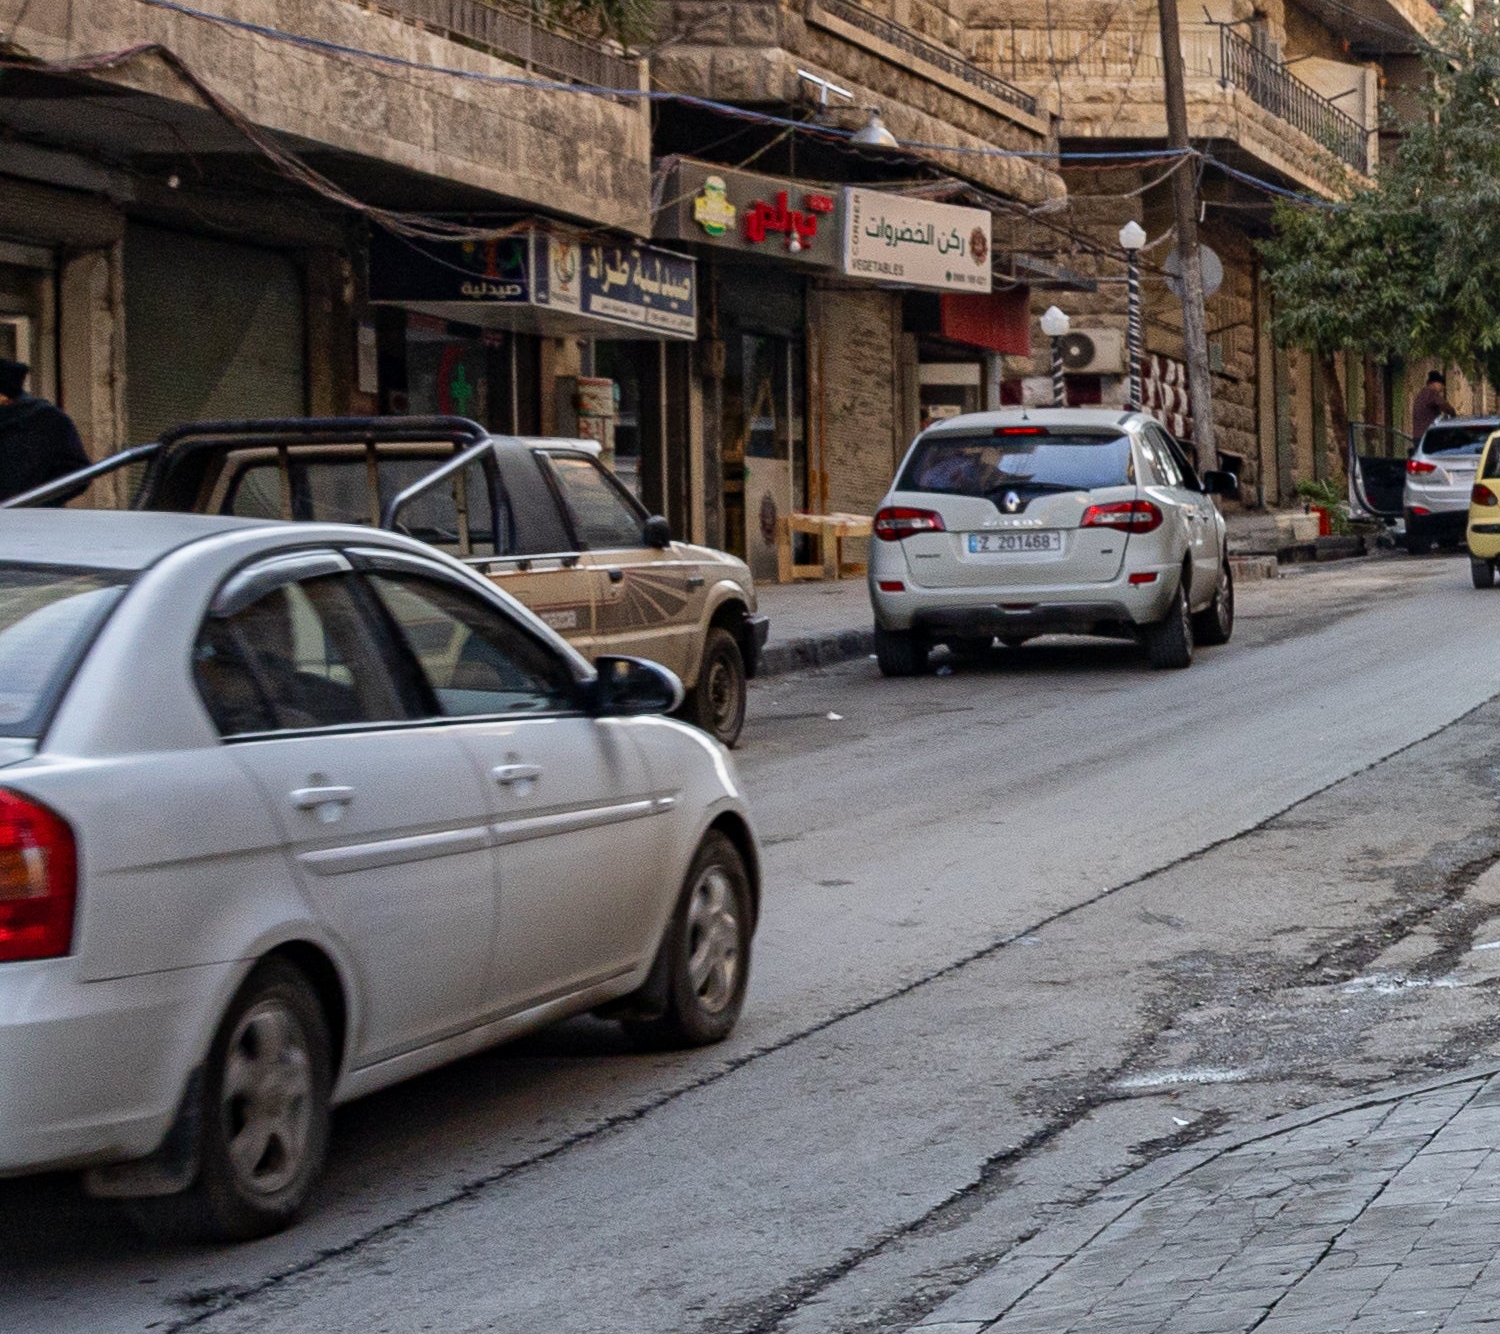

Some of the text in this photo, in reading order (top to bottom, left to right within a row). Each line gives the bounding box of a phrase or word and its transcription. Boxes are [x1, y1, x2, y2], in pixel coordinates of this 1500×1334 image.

[864, 215, 966, 257] ركن الخضروات
[460, 281, 523, 299] صيدلية
